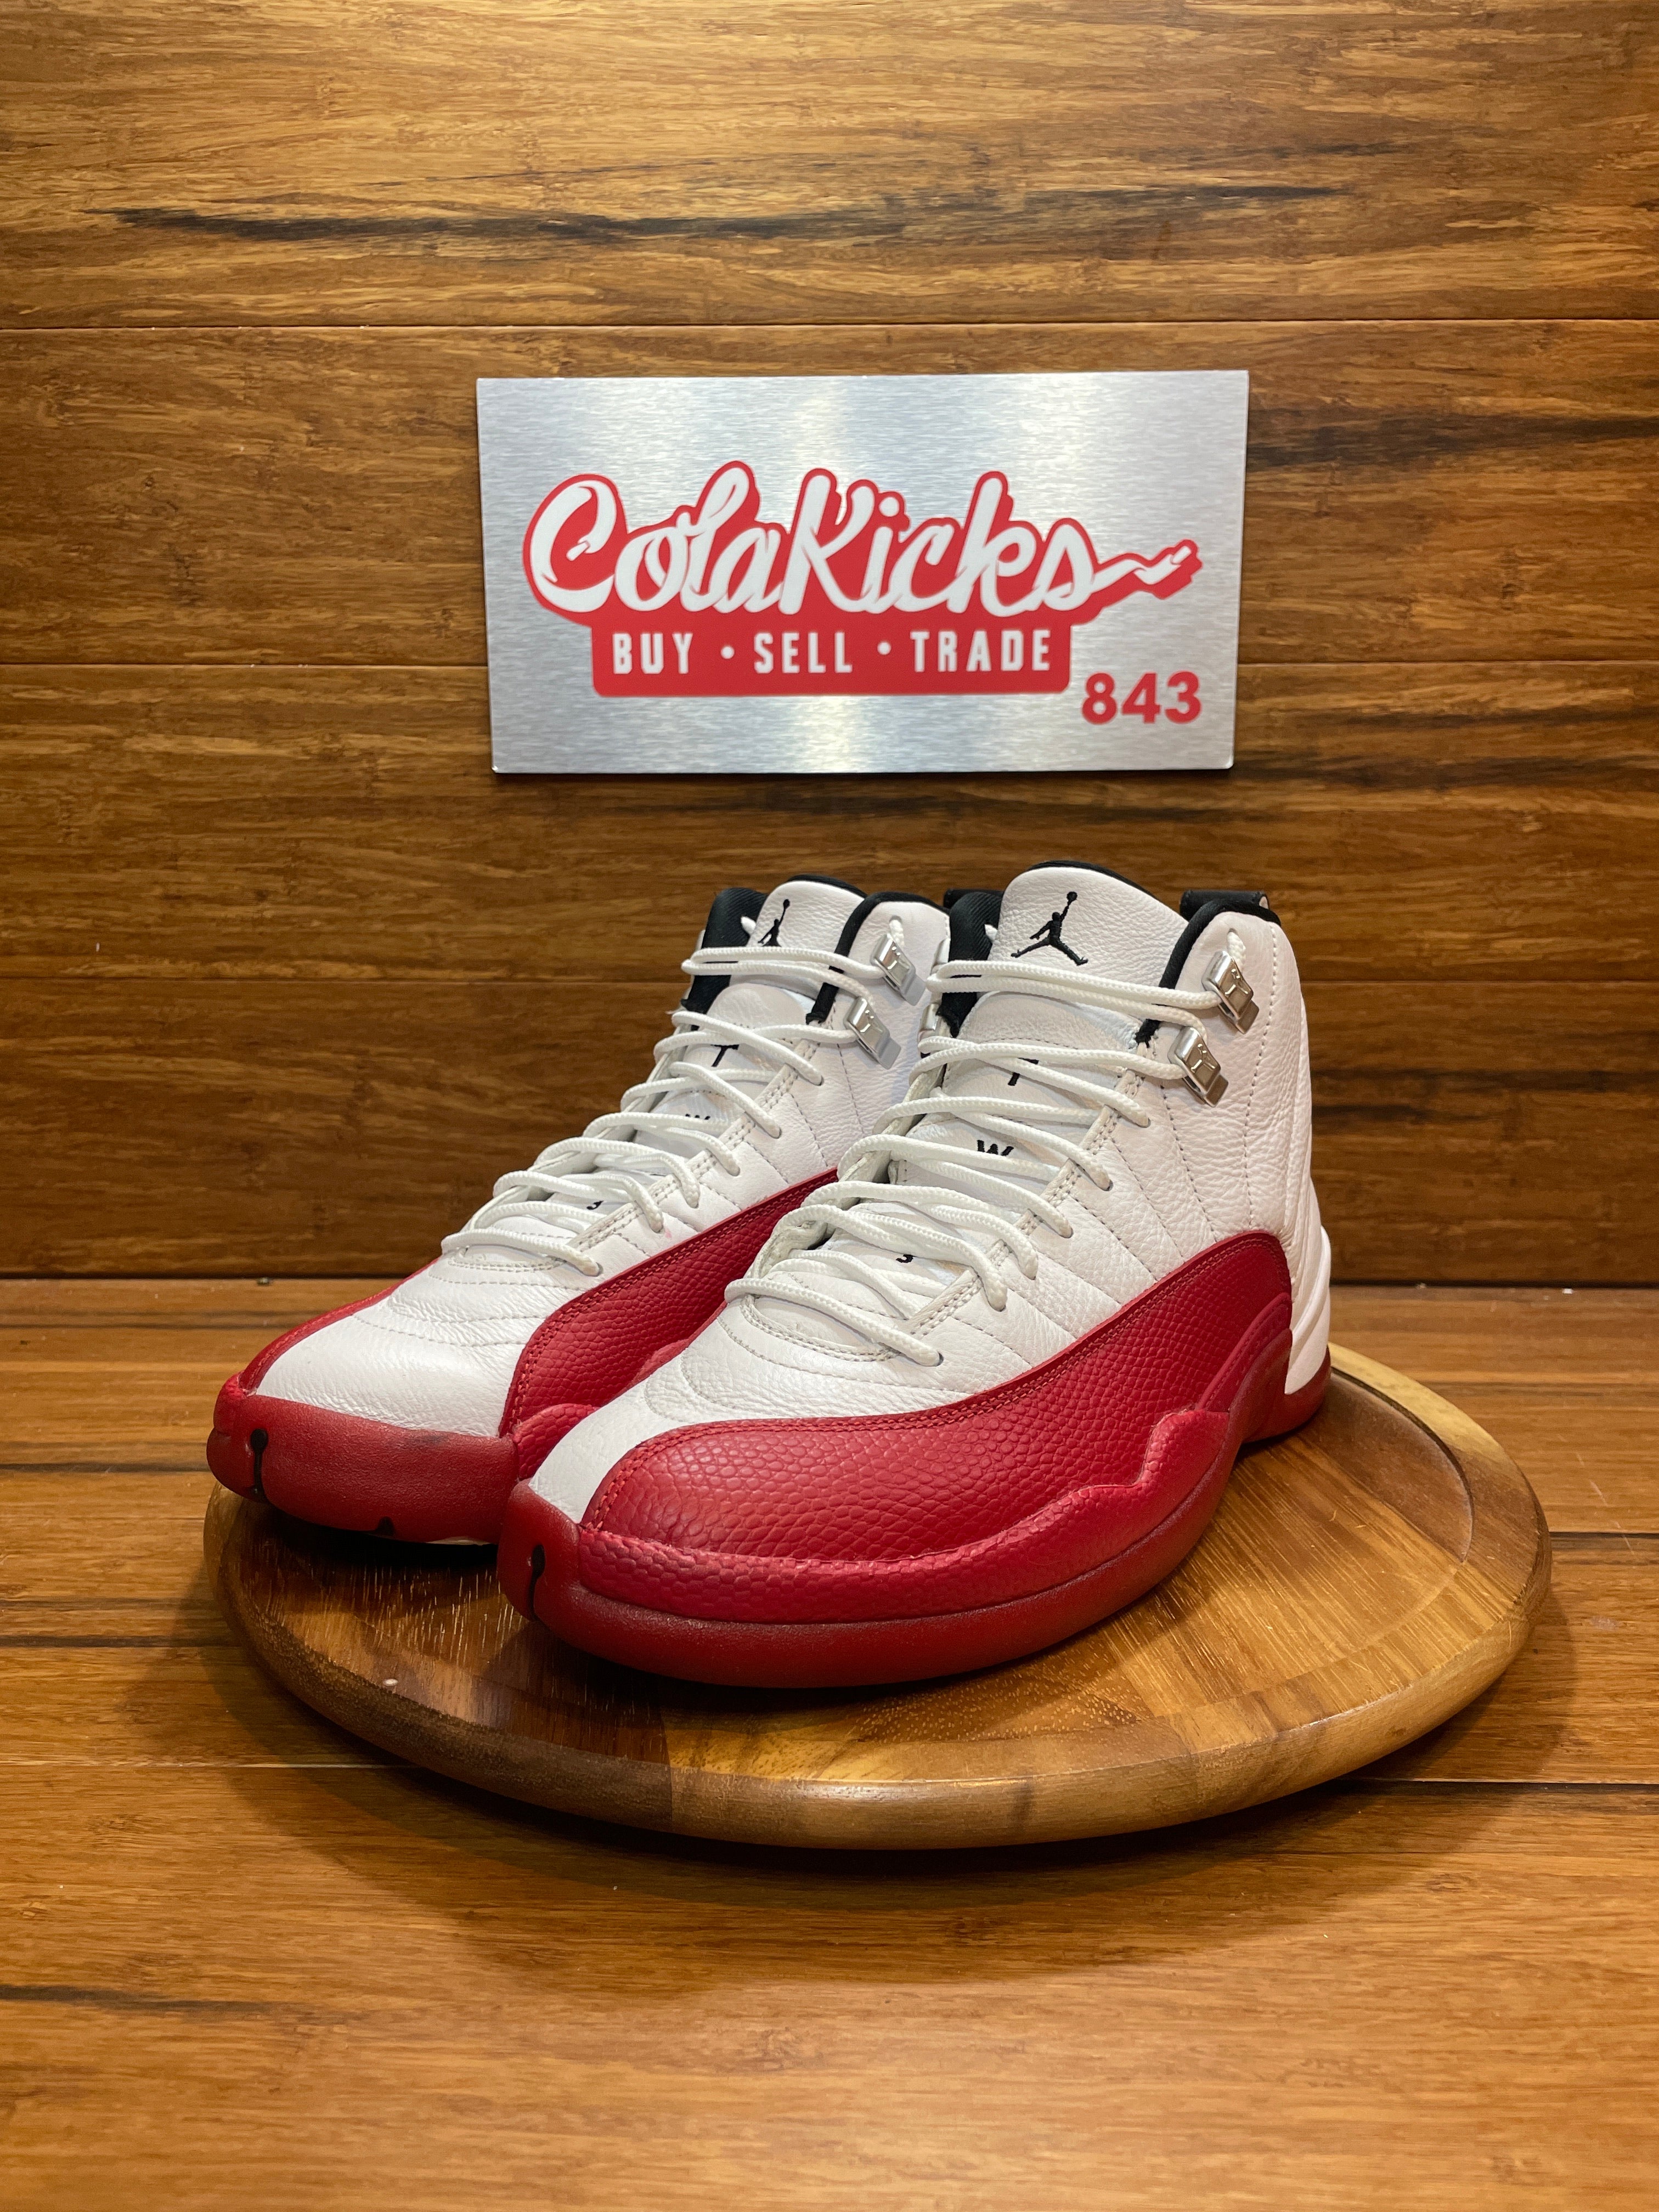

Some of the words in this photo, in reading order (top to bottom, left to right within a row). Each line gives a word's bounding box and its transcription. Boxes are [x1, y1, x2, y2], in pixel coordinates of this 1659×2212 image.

[528, 466, 1193, 618] ColaKicks
[612, 632, 693, 675] BUY
[753, 631, 853, 674] SELL
[910, 629, 1051, 673] TRADE
[1081, 670, 1203, 725] 843
